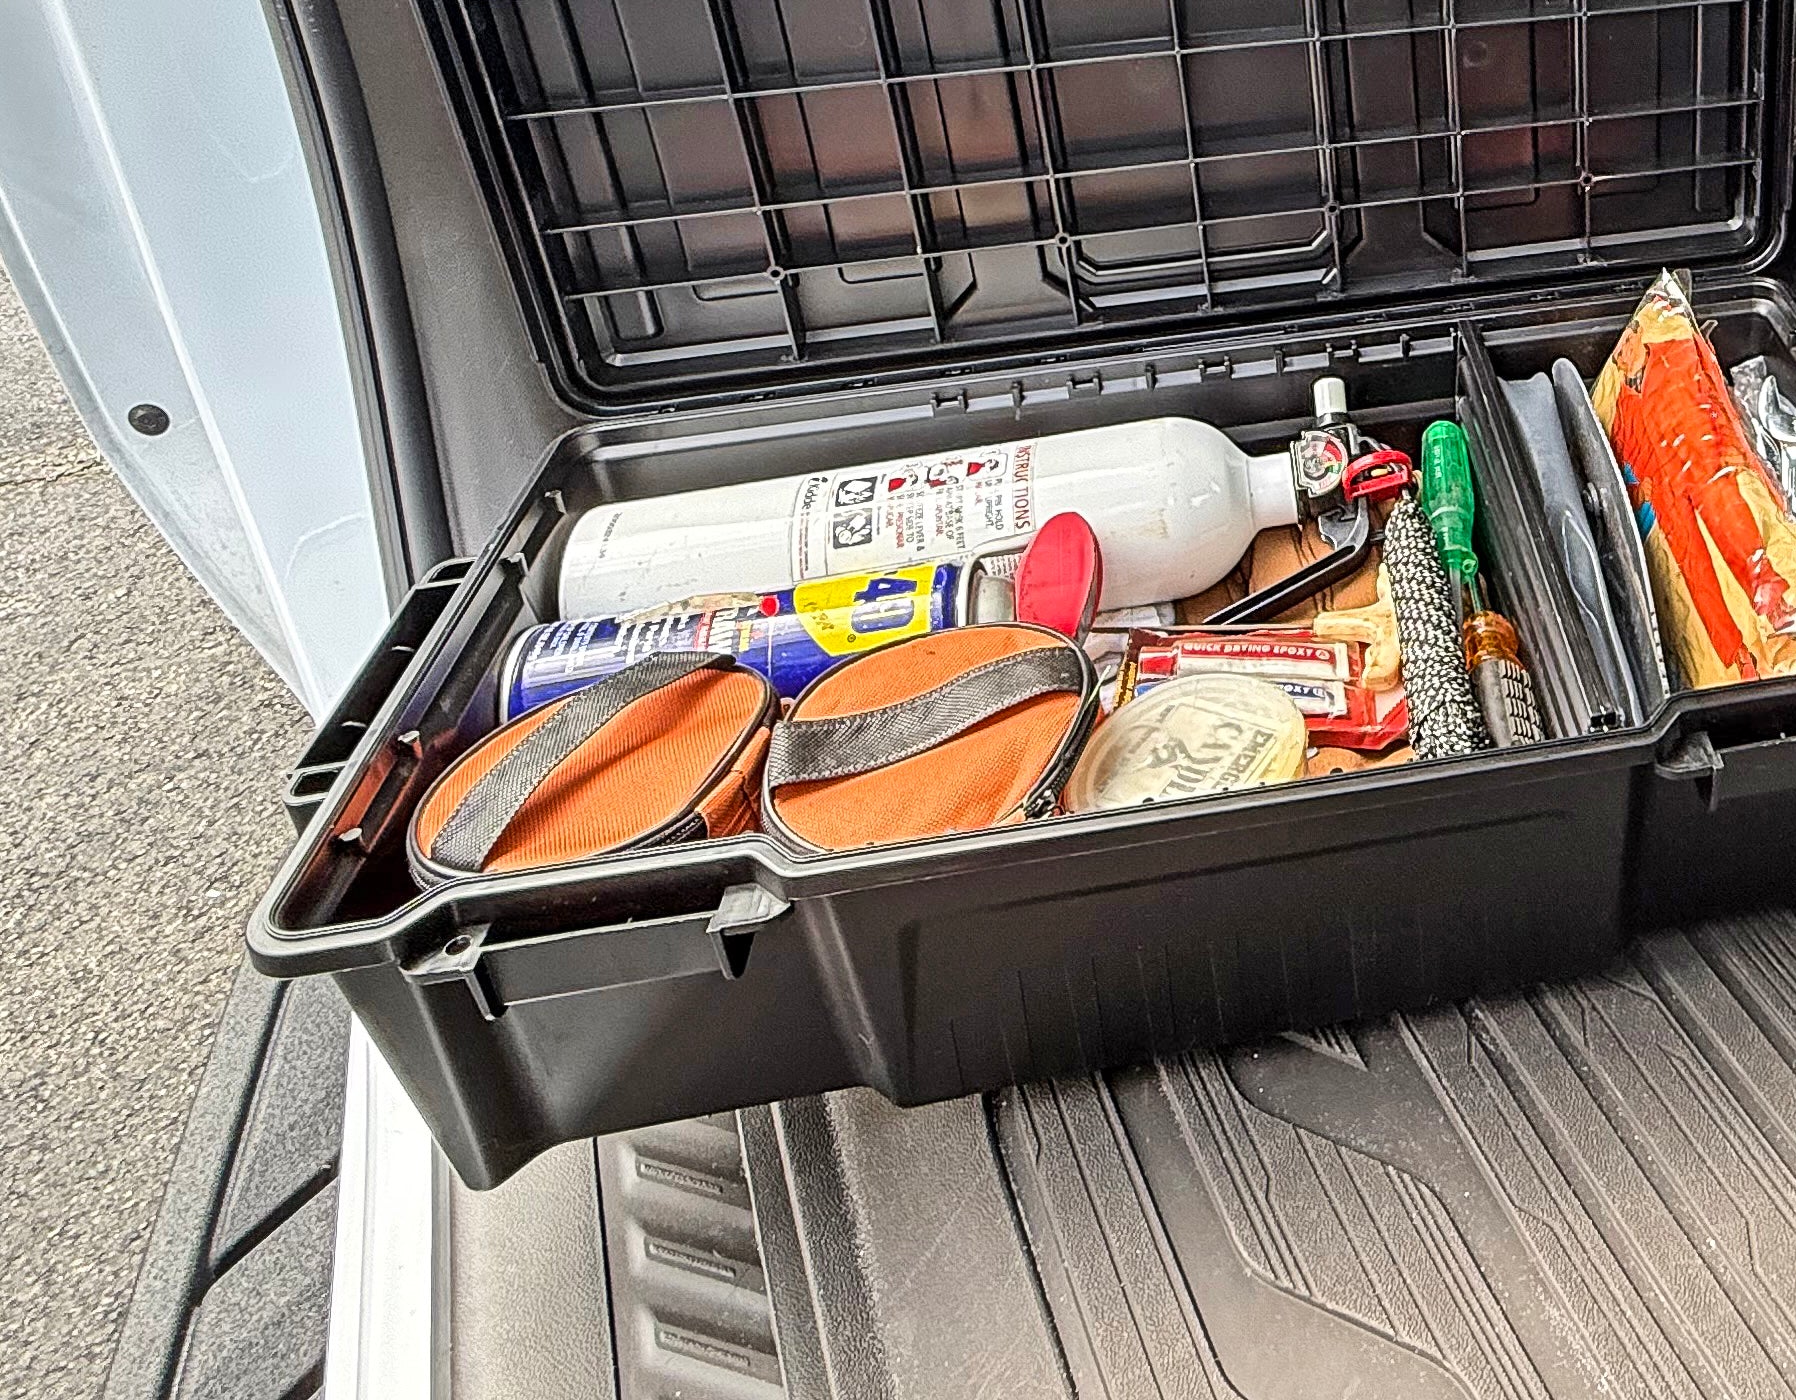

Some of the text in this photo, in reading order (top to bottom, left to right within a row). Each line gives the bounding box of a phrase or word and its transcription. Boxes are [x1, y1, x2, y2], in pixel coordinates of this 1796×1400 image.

[802, 481, 819, 510] Kidde
[1014, 444, 1032, 531] INSTRUCTIONS
[1183, 642, 1221, 653] QUICK
[1226, 643, 1272, 655] DRYING
[1273, 645, 1313, 658] EPOXY
